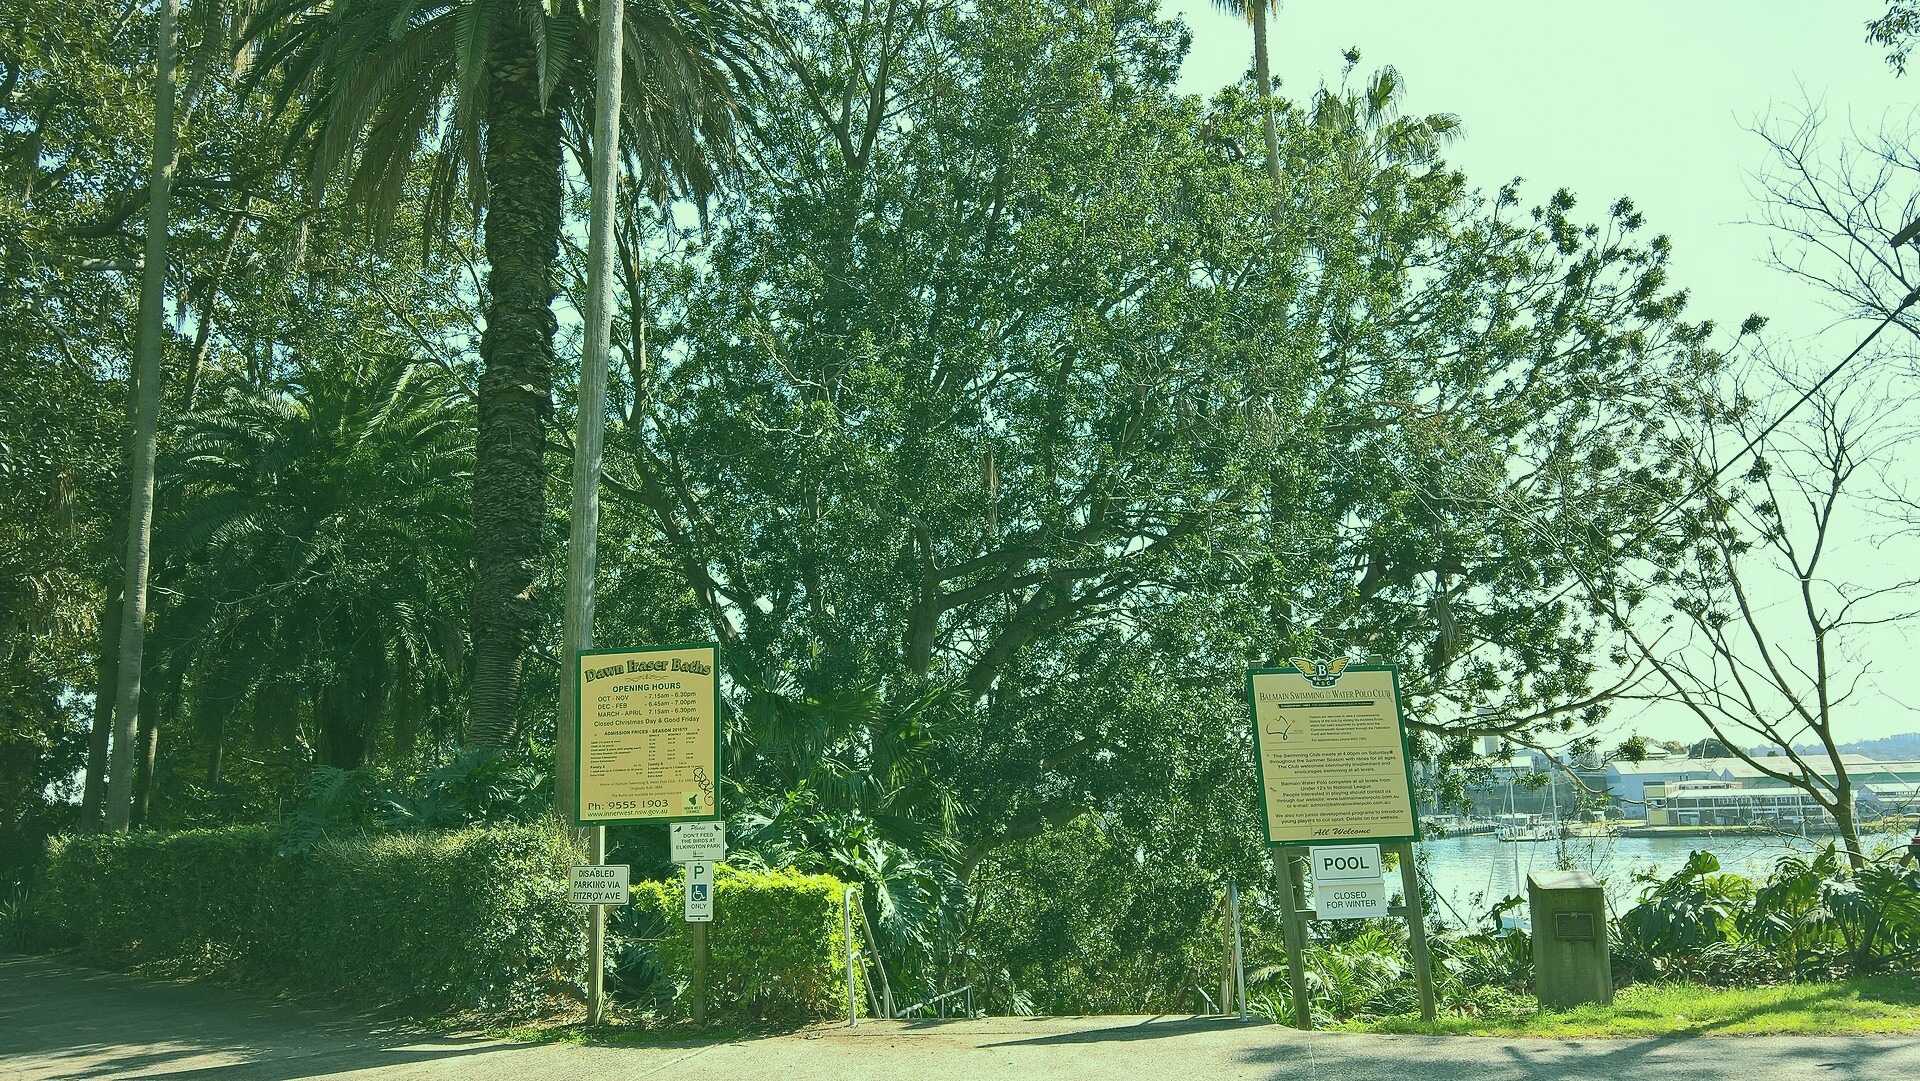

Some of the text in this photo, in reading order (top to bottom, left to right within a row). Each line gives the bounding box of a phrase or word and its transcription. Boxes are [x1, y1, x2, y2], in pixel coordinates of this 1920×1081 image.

[584, 658, 711, 682] Dawn Fraser Baths
[613, 682, 681, 692] OPENING HOURS
[1260, 692, 1289, 701] BALMAIN
[1290, 691, 1324, 700] SWIMMING
[1332, 690, 1354, 698] WATER
[1355, 689, 1372, 698] POLO
[608, 801, 636, 809] 9555
[642, 800, 668, 808] 1903
[1324, 857, 1369, 870] POOL
[694, 866, 704, 879] P
[1334, 891, 1367, 900] CLOSED
